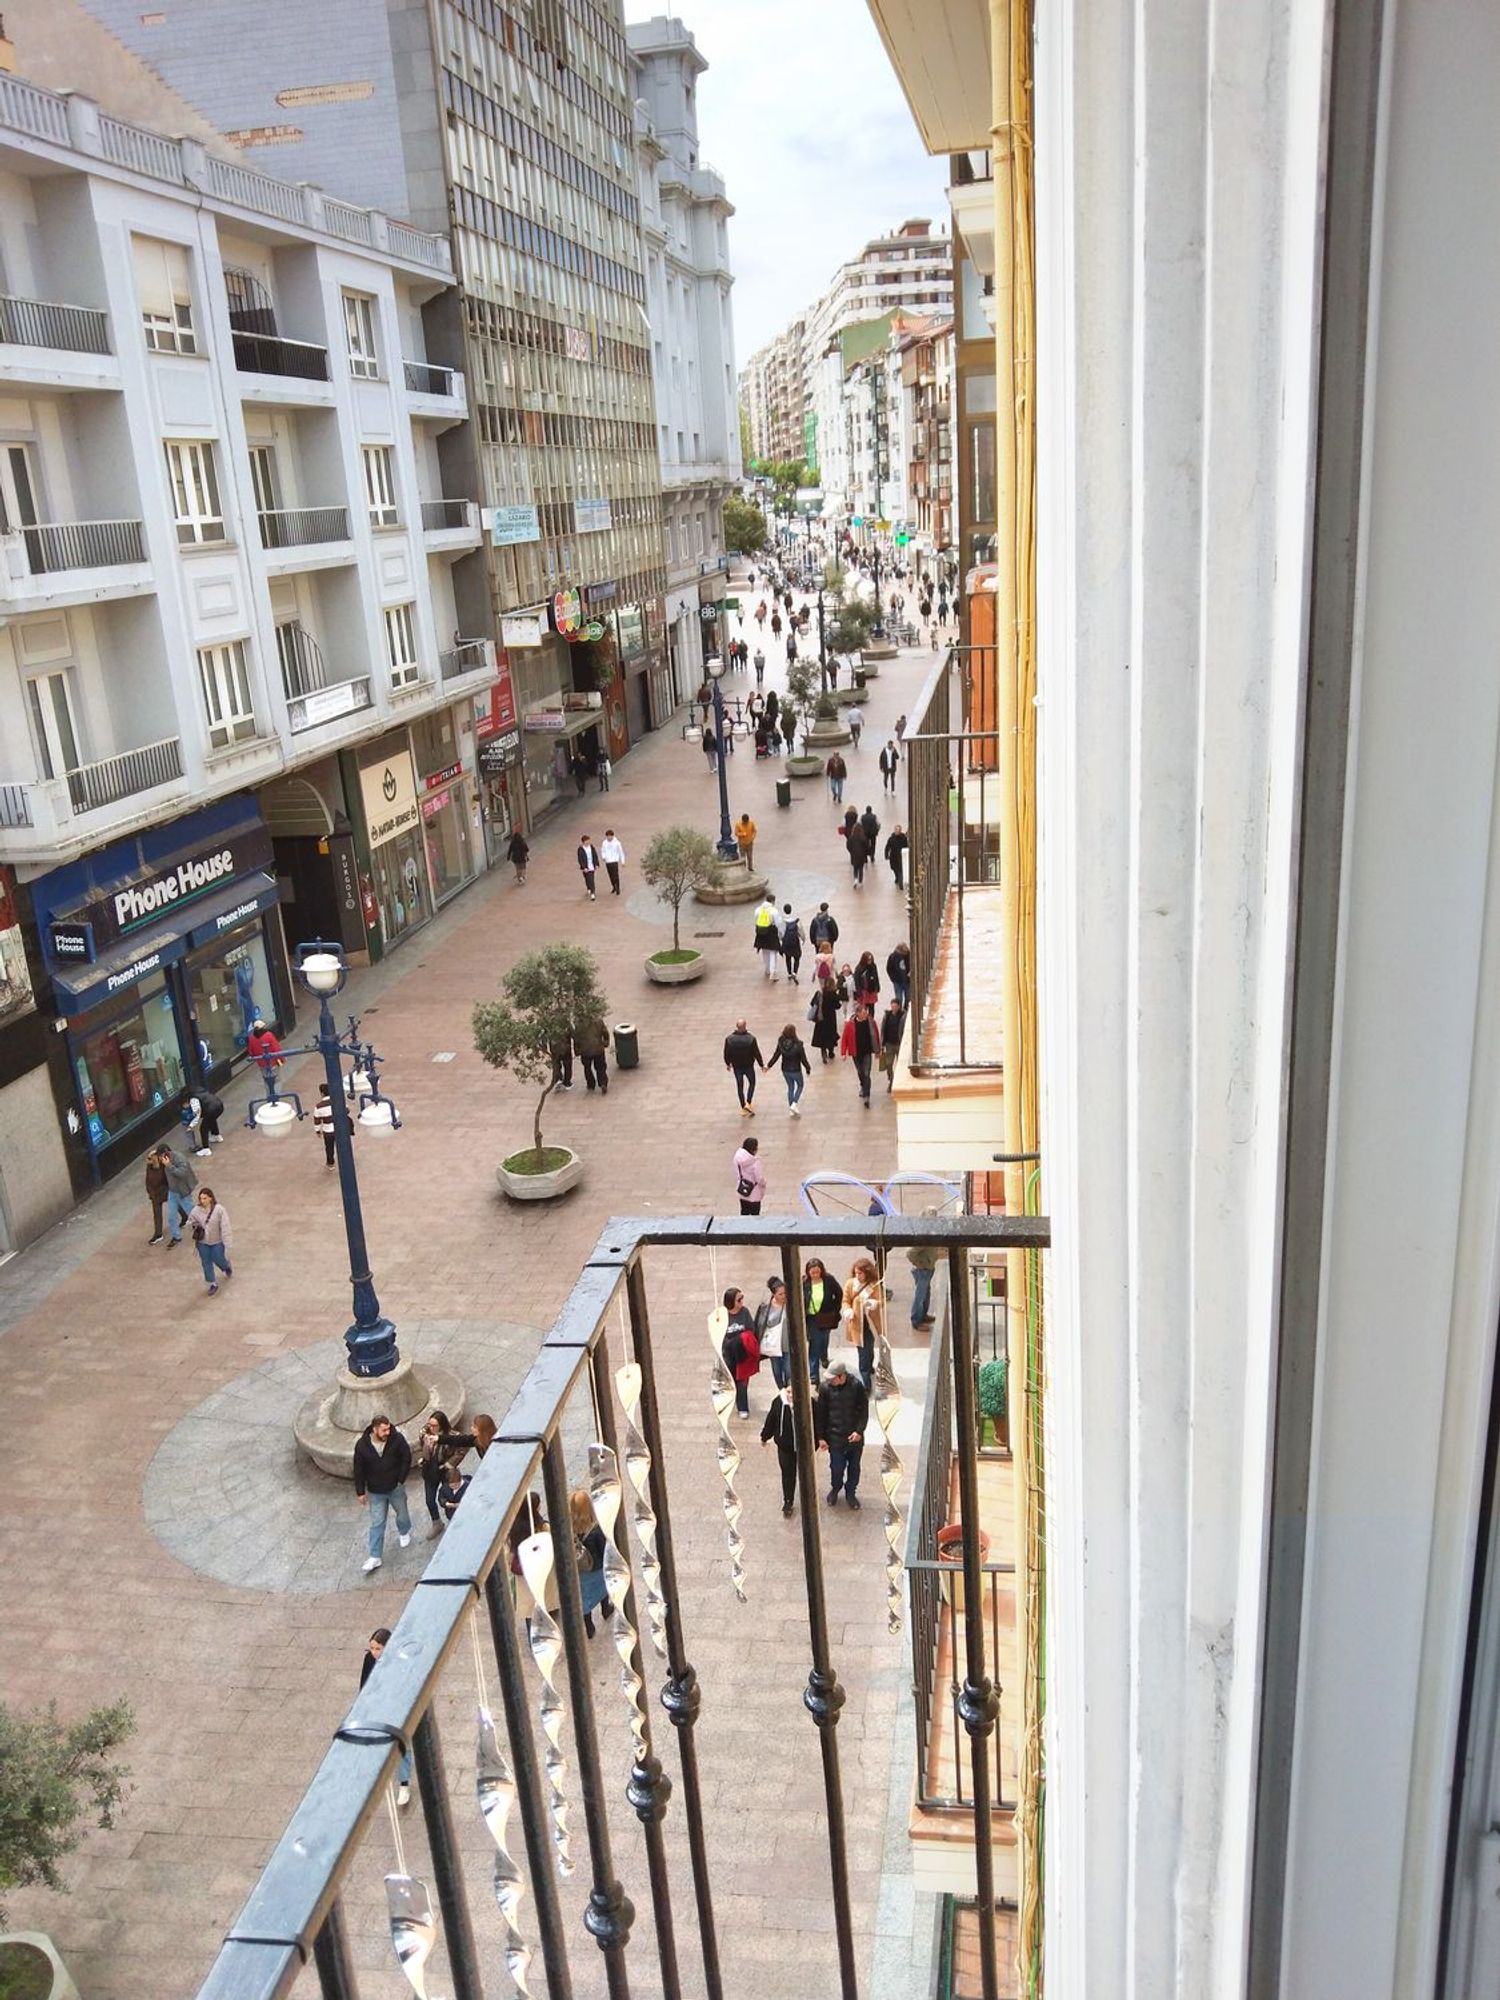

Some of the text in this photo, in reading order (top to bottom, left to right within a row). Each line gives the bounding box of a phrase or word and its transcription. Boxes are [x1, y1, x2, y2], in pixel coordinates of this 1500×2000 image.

[114, 850, 234, 925] Phone House
[216, 900, 259, 929] Phone House
[55, 935, 84, 944] Phone
[56, 943, 86, 952] House
[107, 954, 160, 990] Phone House
